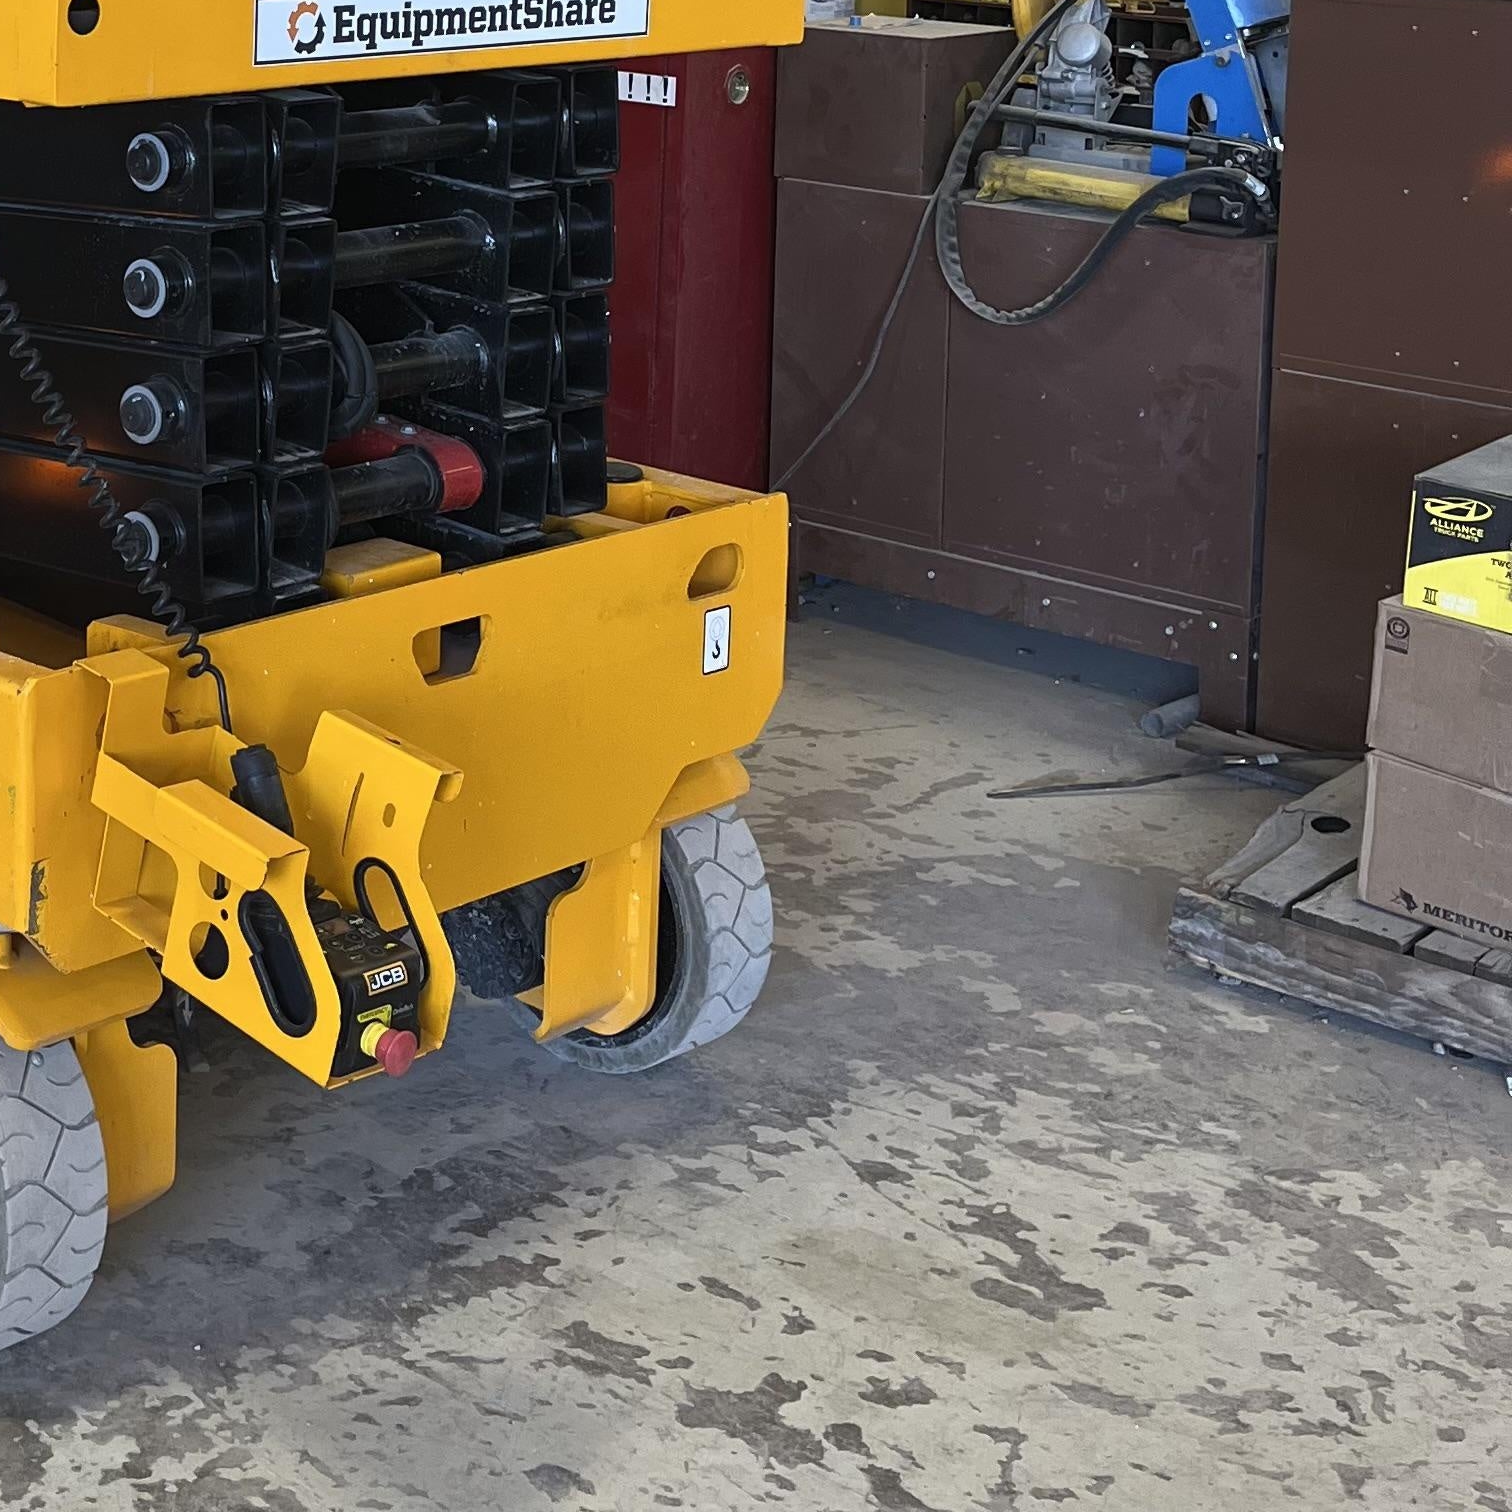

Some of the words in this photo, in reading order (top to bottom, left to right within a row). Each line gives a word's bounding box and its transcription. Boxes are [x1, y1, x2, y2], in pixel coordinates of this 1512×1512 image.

[1430, 517, 1485, 538] ALLIANCE
[1434, 526, 1456, 537] TRUCK
[1457, 533, 1480, 543] PARTS
[371, 966, 405, 990] JCB
